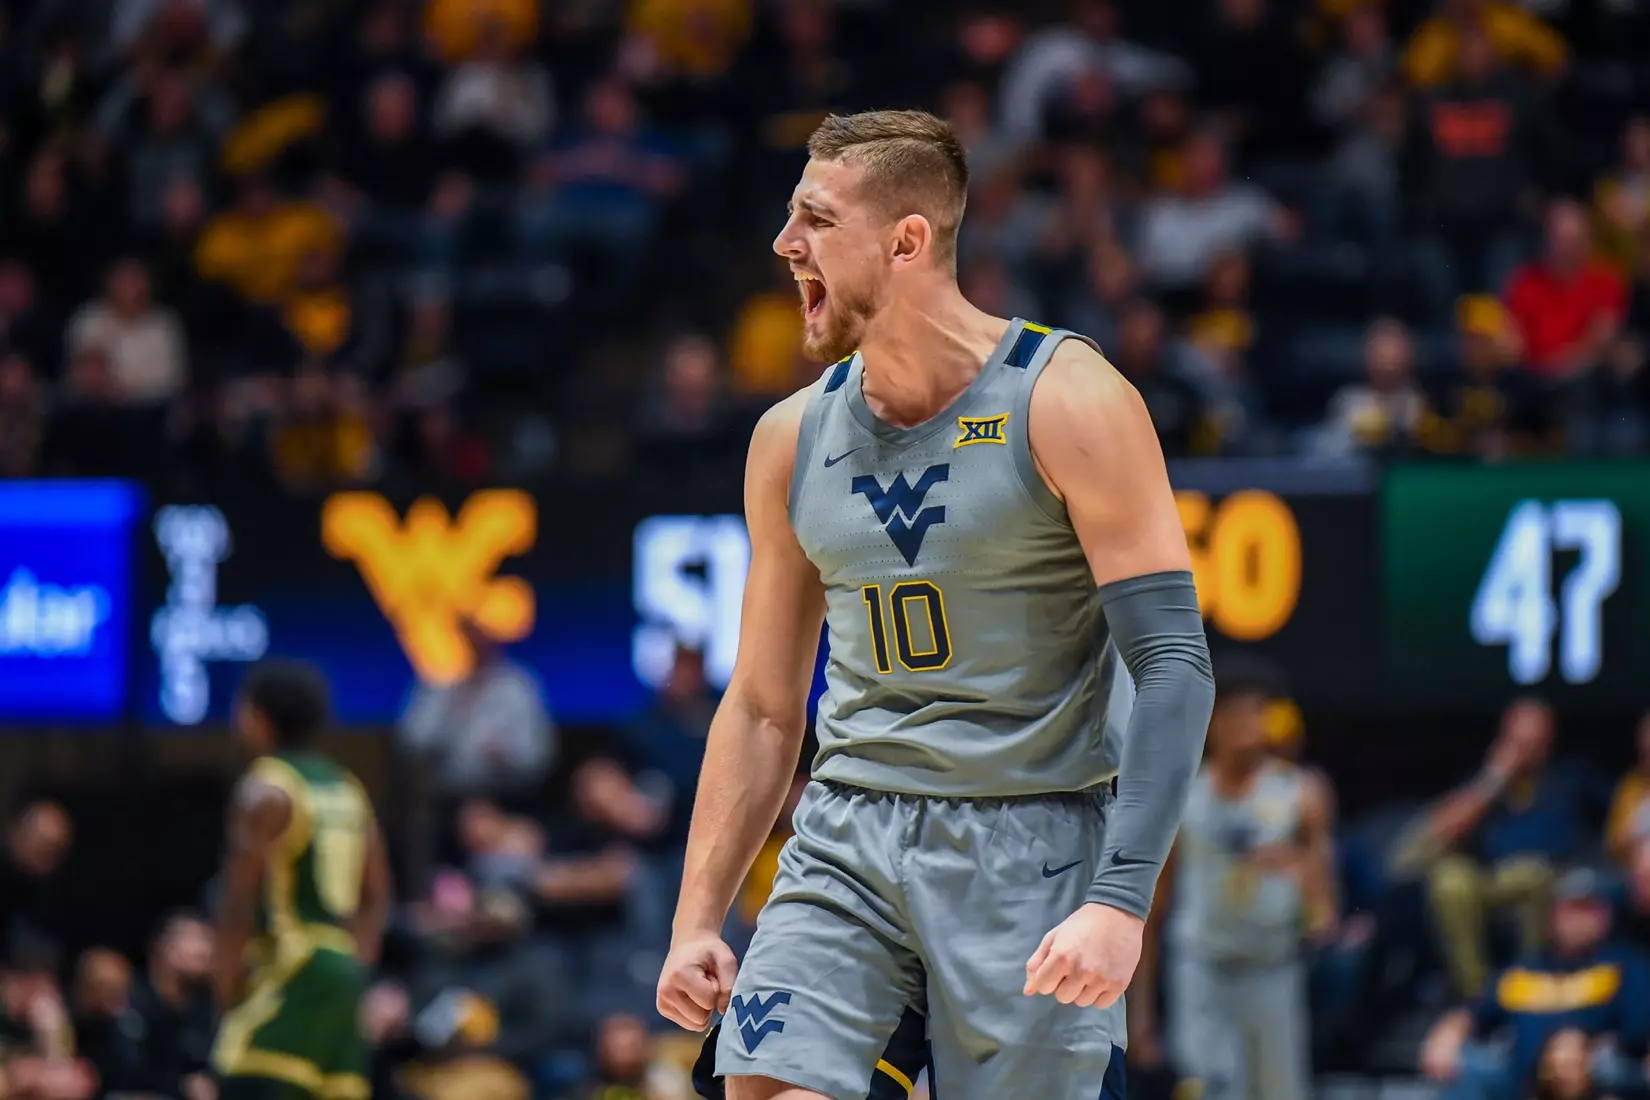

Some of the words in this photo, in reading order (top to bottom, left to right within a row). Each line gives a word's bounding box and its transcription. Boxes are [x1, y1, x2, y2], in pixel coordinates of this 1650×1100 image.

[958, 417, 1005, 443] XII
[862, 580, 952, 674] 10
[1471, 498, 1621, 684] 47
